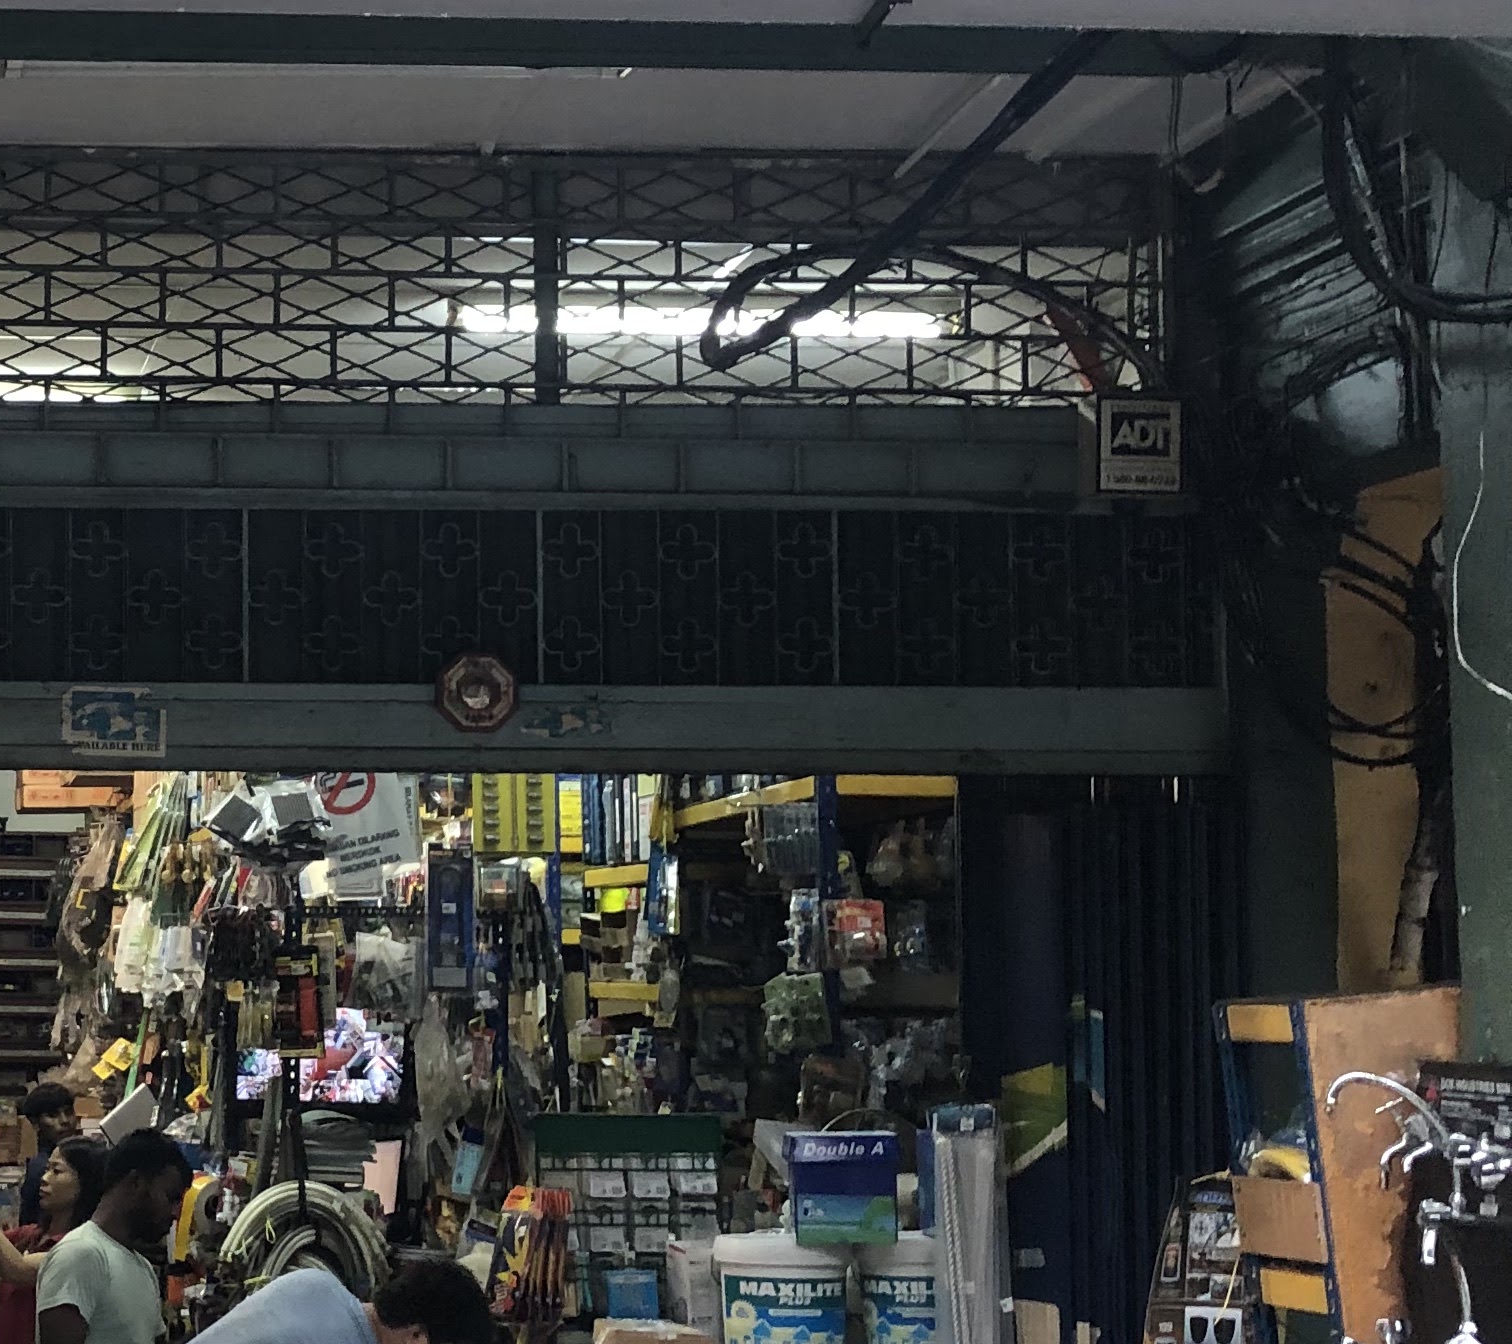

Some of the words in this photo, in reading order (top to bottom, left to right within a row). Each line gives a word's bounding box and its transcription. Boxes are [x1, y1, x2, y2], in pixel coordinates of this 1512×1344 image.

[1112, 418, 1171, 450] ADT
[802, 1140, 865, 1157] Double
[870, 1140, 885, 1156] A
